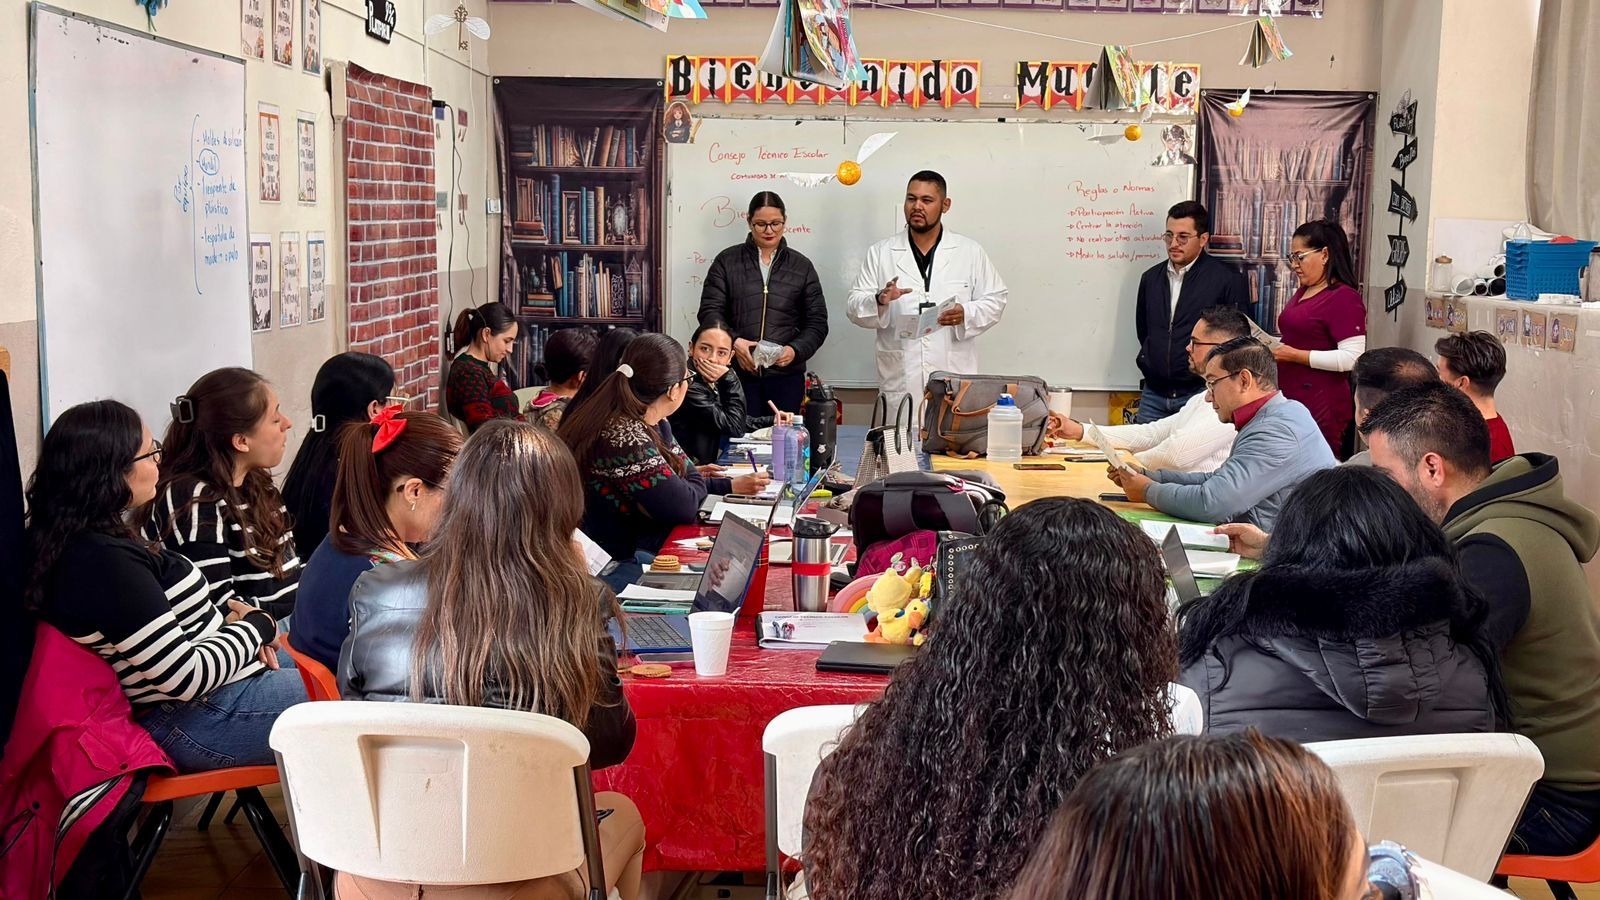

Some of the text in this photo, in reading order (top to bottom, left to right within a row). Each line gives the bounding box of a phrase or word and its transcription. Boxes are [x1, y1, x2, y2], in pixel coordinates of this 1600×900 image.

[670, 55, 1193, 105] Biennido Mule
[708, 142, 746, 165] Consejo
[792, 147, 829, 159] Escolar
[1067, 180, 1109, 202] Reglas
[1122, 180, 1155, 192] Normas
[1129, 202, 1154, 216] Activa
[783, 224, 811, 234] ocente
[1076, 220, 1102, 230] Centrar
[1076, 235, 1085, 243] No
